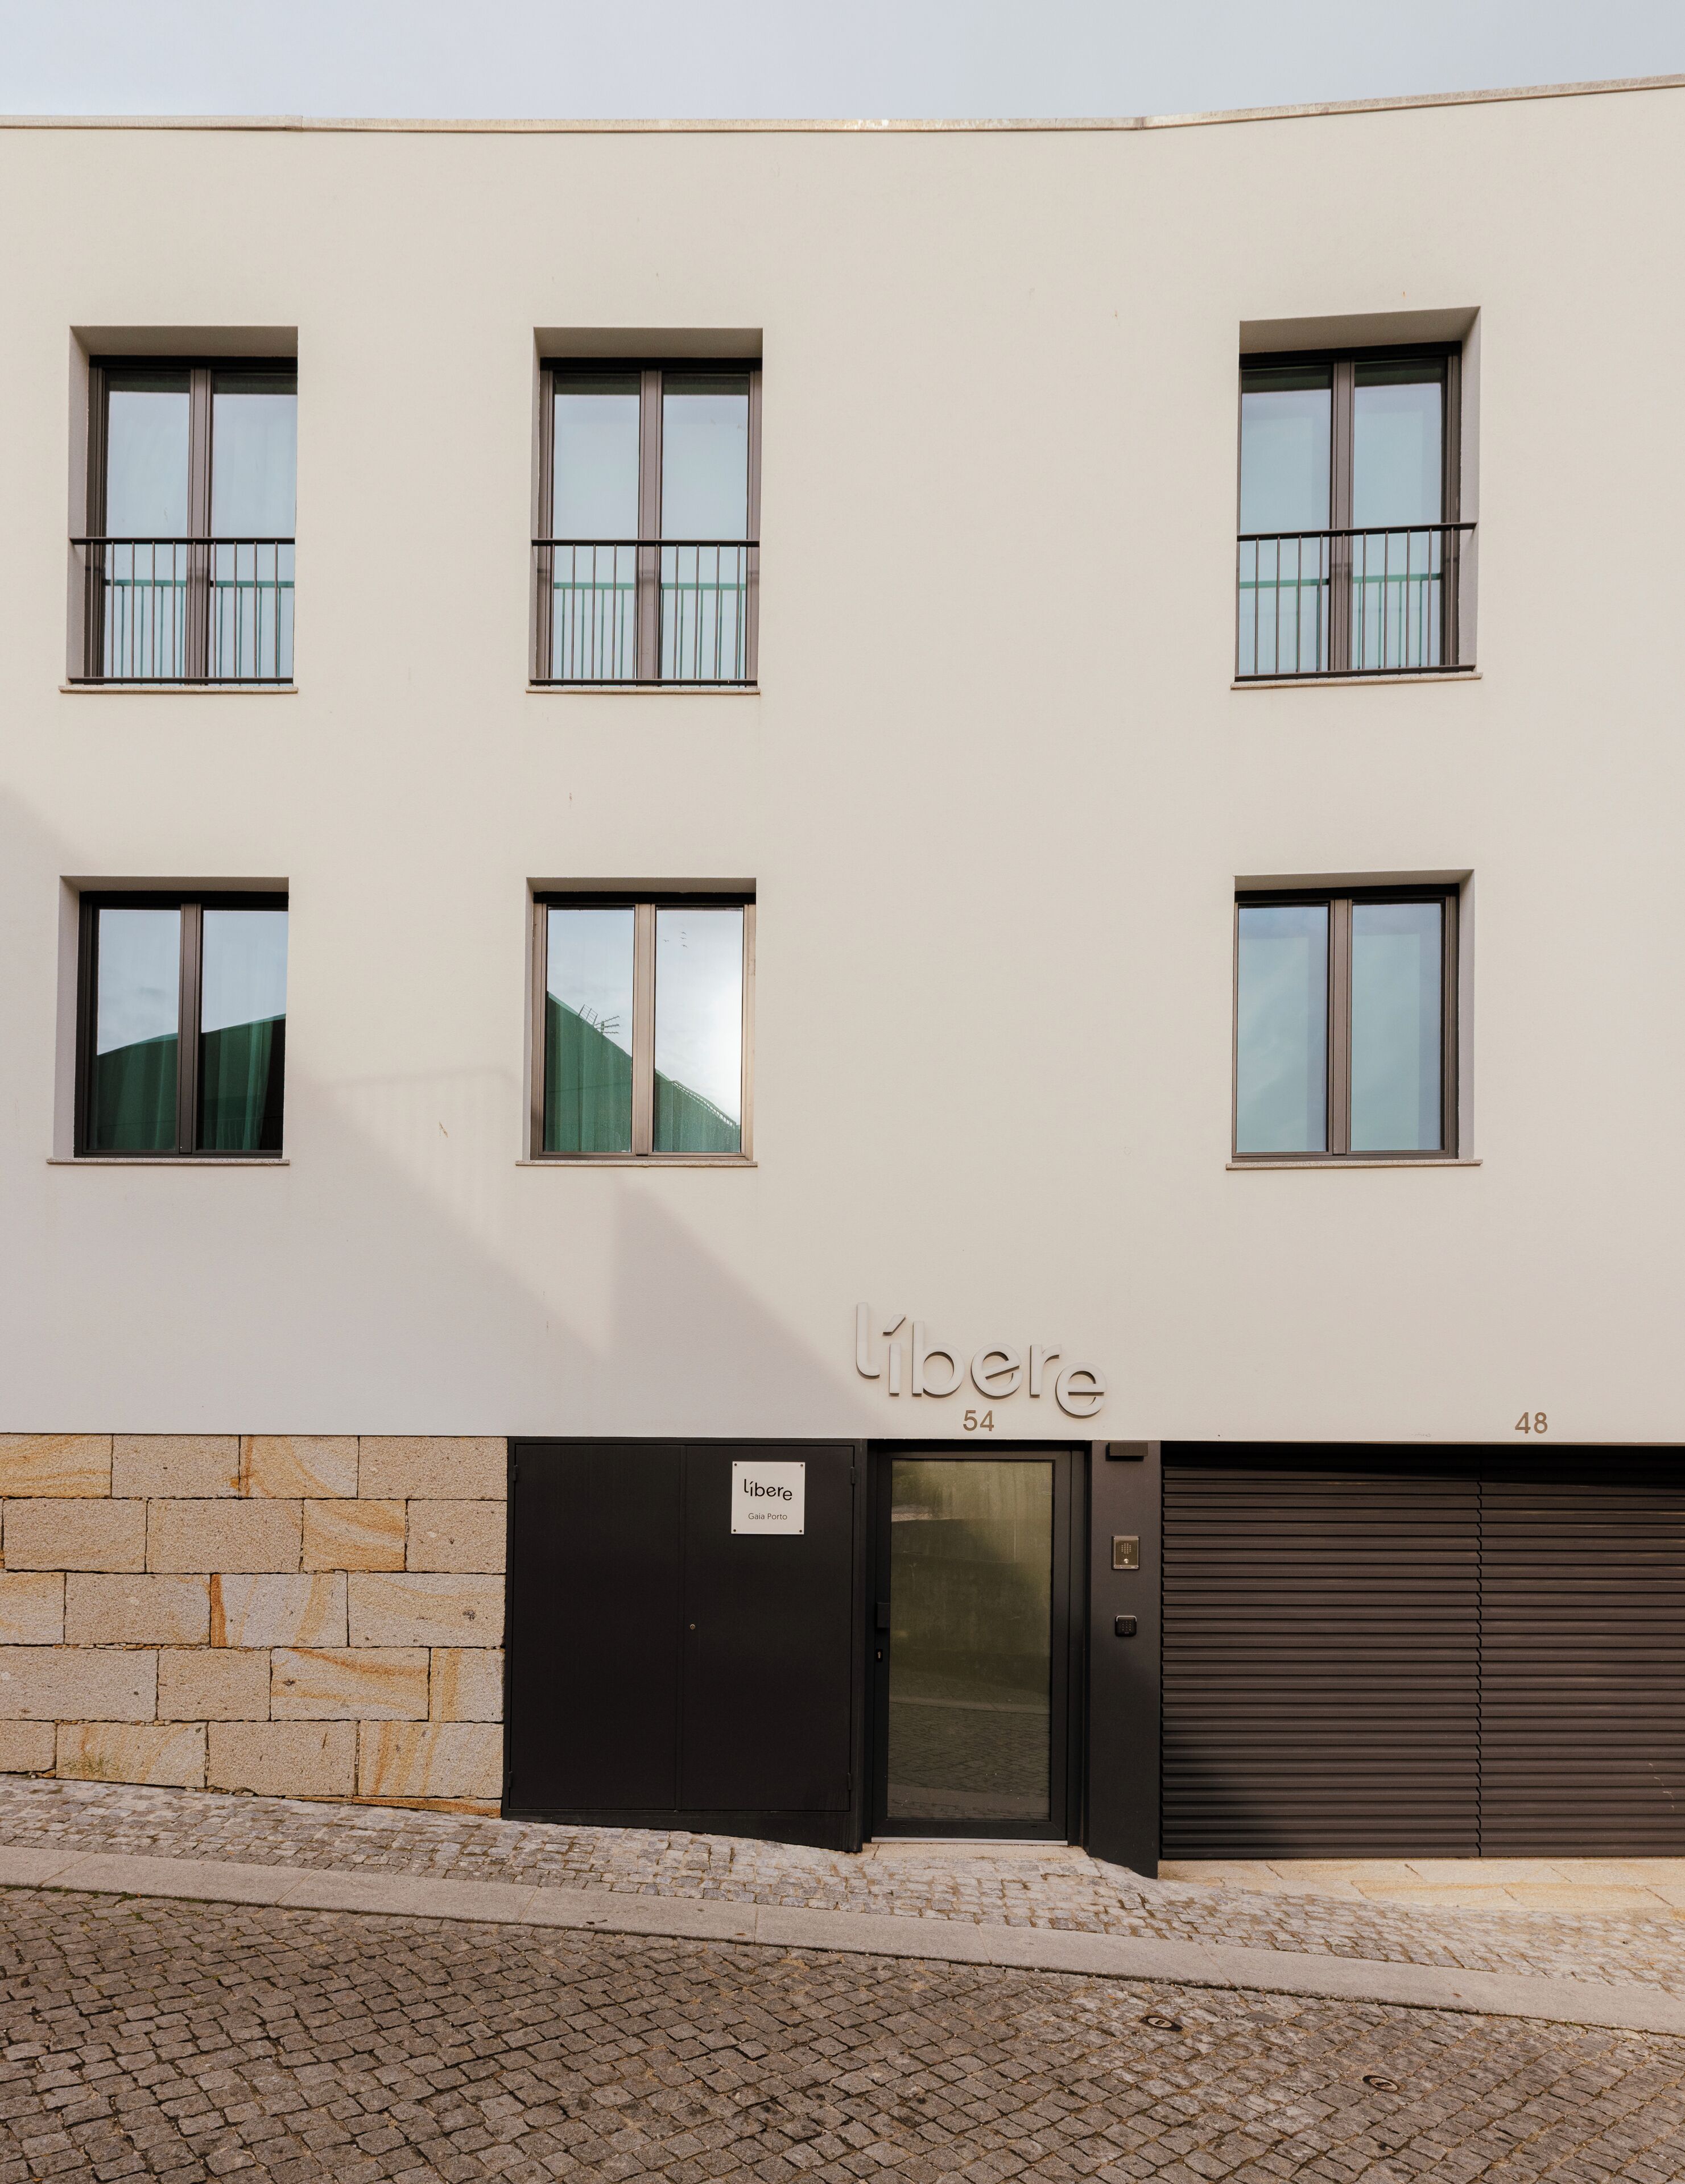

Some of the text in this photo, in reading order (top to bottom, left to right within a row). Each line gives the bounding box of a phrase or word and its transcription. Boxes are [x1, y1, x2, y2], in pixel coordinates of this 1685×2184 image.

[856, 1302, 1108, 1417] líbere
[963, 1409, 994, 1432] 54
[1514, 1412, 1548, 1434] 48
[744, 1478, 792, 1501] líbere
